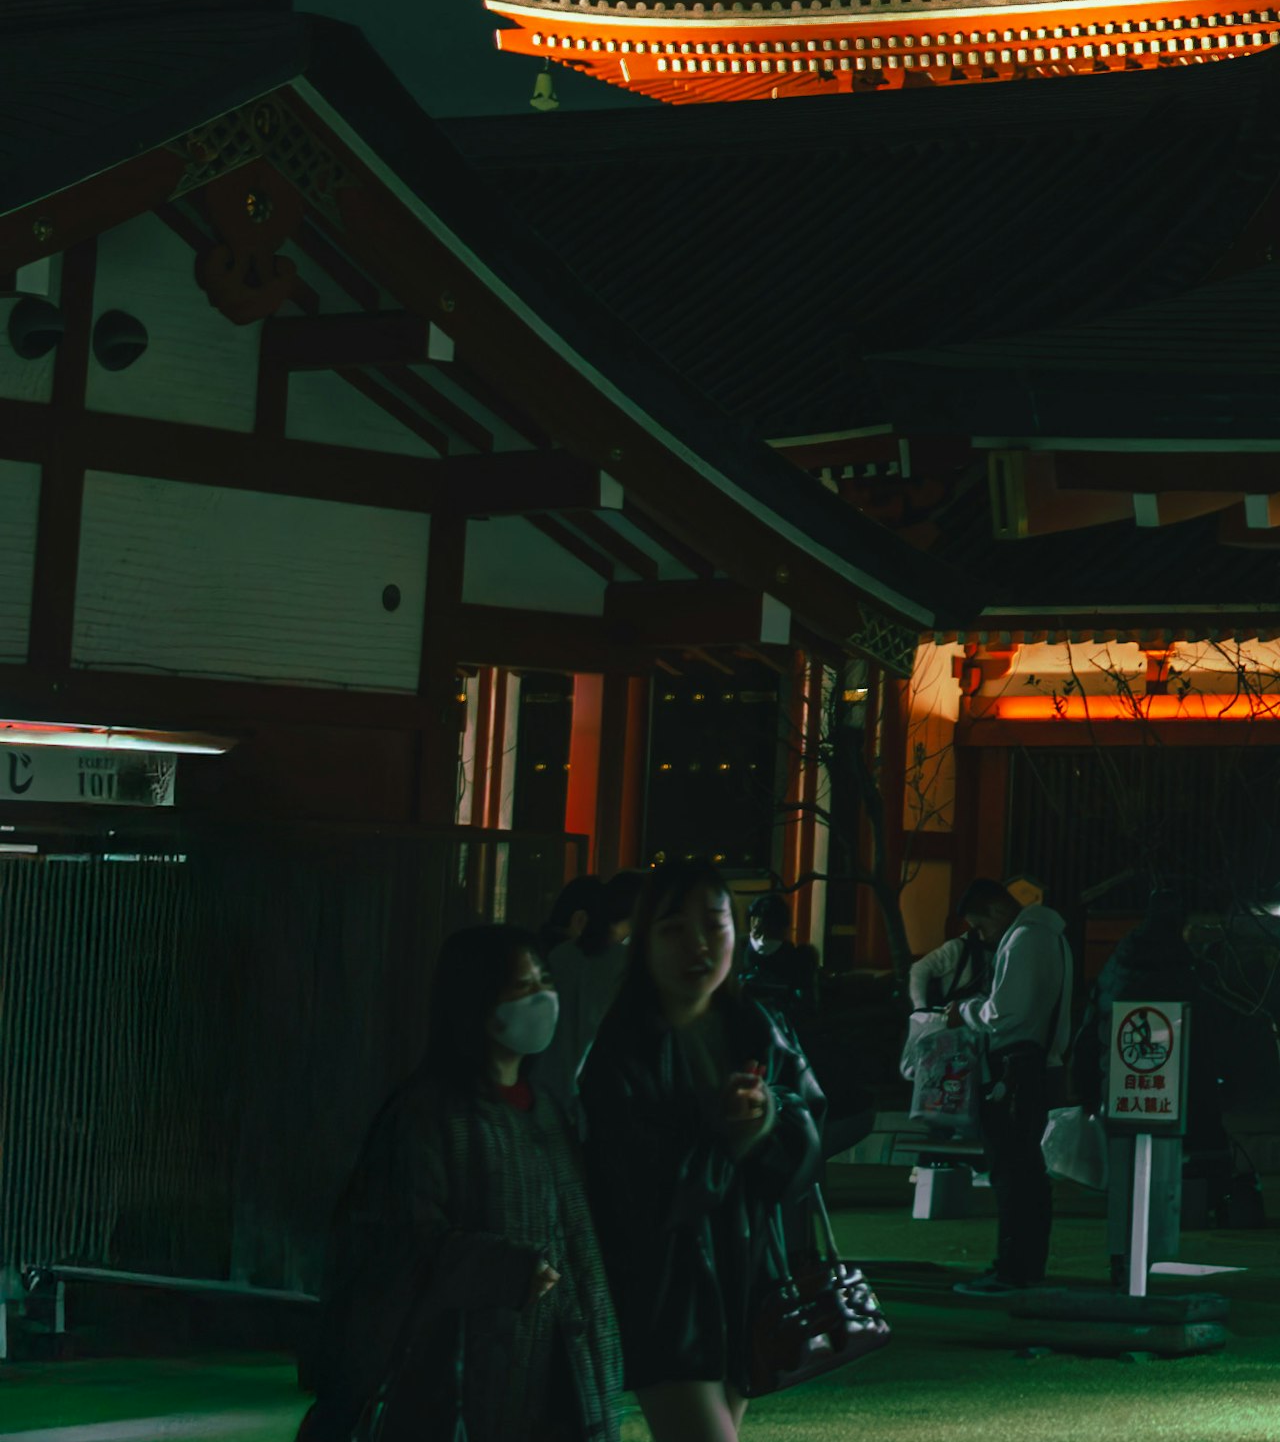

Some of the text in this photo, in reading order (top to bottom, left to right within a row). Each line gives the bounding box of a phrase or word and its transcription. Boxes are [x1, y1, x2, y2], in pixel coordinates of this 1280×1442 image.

[1125, 1074, 1166, 1090] 自転車
[1116, 1097, 1173, 1114] 進入禁止
